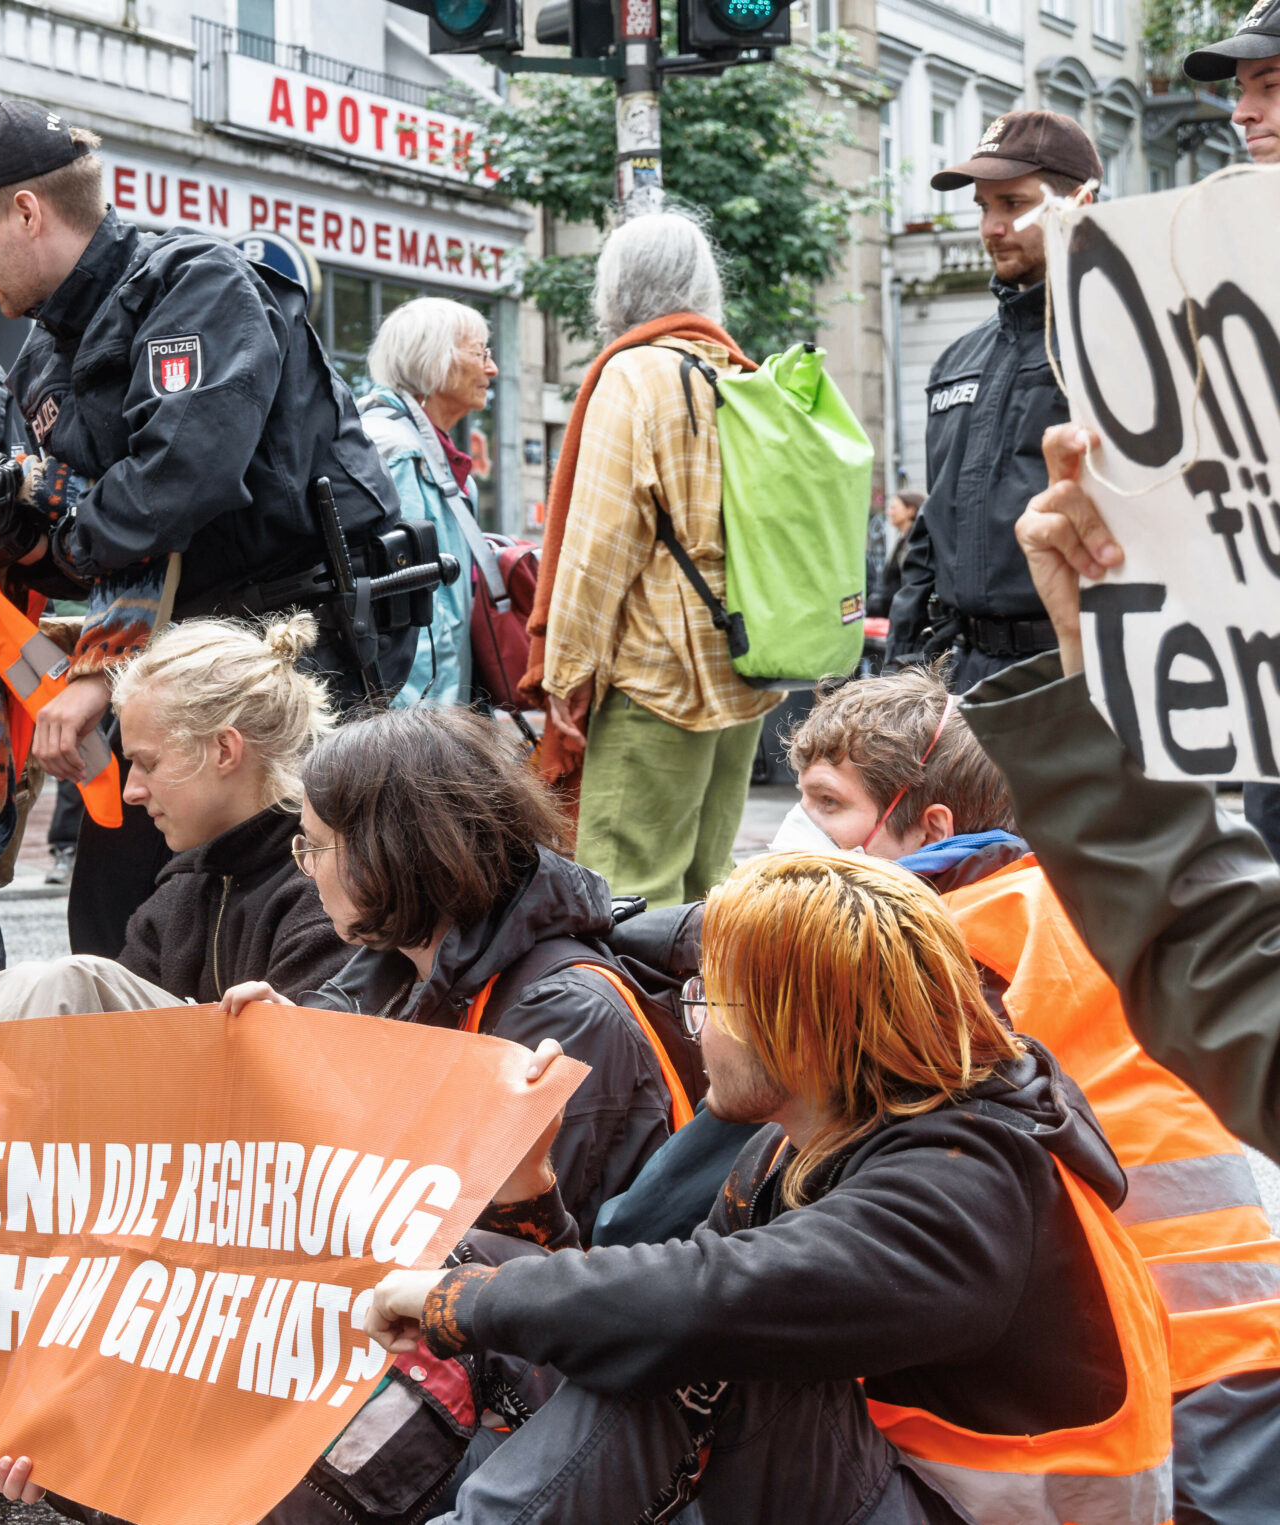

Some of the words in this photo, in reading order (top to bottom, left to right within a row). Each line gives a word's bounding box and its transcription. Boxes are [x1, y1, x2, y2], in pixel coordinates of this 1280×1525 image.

[249, 194, 507, 282] PFERDEMARKT
[151, 341, 197, 356] POLIZEI
[90, 1142, 172, 1237] DIE
[161, 1139, 462, 1268] REGIERUNG
[98, 1259, 257, 1385] GRIFF
